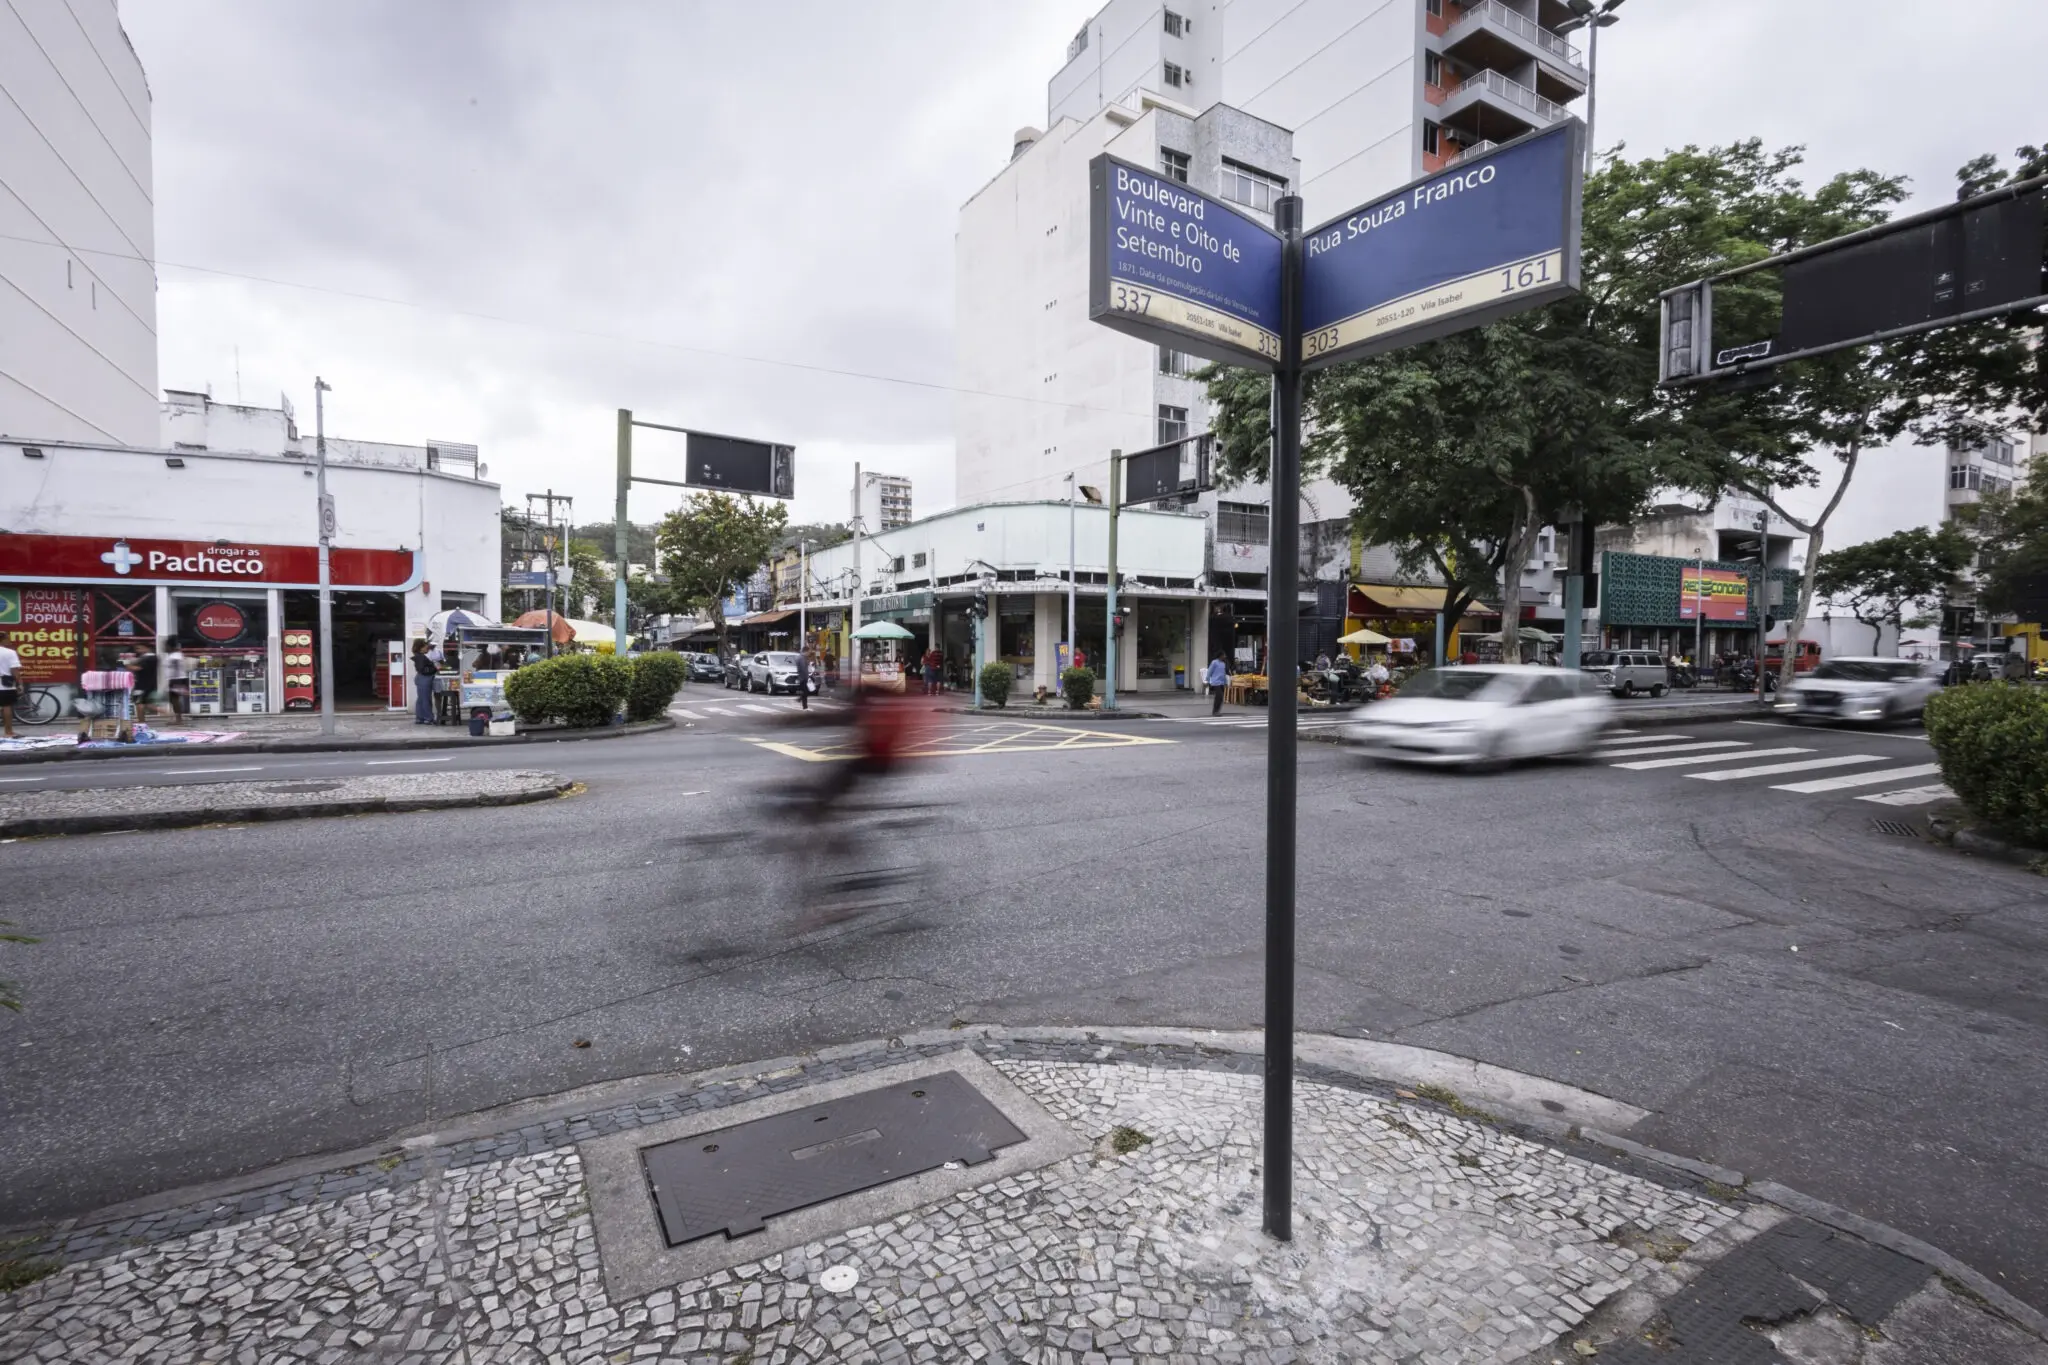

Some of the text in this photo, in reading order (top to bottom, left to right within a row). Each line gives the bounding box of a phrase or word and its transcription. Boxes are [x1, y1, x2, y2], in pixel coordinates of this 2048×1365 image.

[1117, 167, 1204, 221] Boulevard
[1309, 165, 1496, 258] Rua Souza Franco
[1116, 196, 1240, 263] Vinte e Oito de
[1116, 226, 1202, 274] Setembro
[1139, 266, 1156, 281] Data
[1156, 271, 1166, 283] da
[1501, 258, 1551, 293] 161
[1116, 286, 1152, 316] 337
[1375, 291, 1463, 327] 20551-120 Vila Isabel
[1258, 331, 1278, 358] 313
[1307, 327, 1339, 356] 303
[149, 550, 264, 575] Pacheco
[25, 590, 58, 601] AQUI
[25, 601, 92, 613] FARMÁCA
[9, 628, 89, 642] médio
